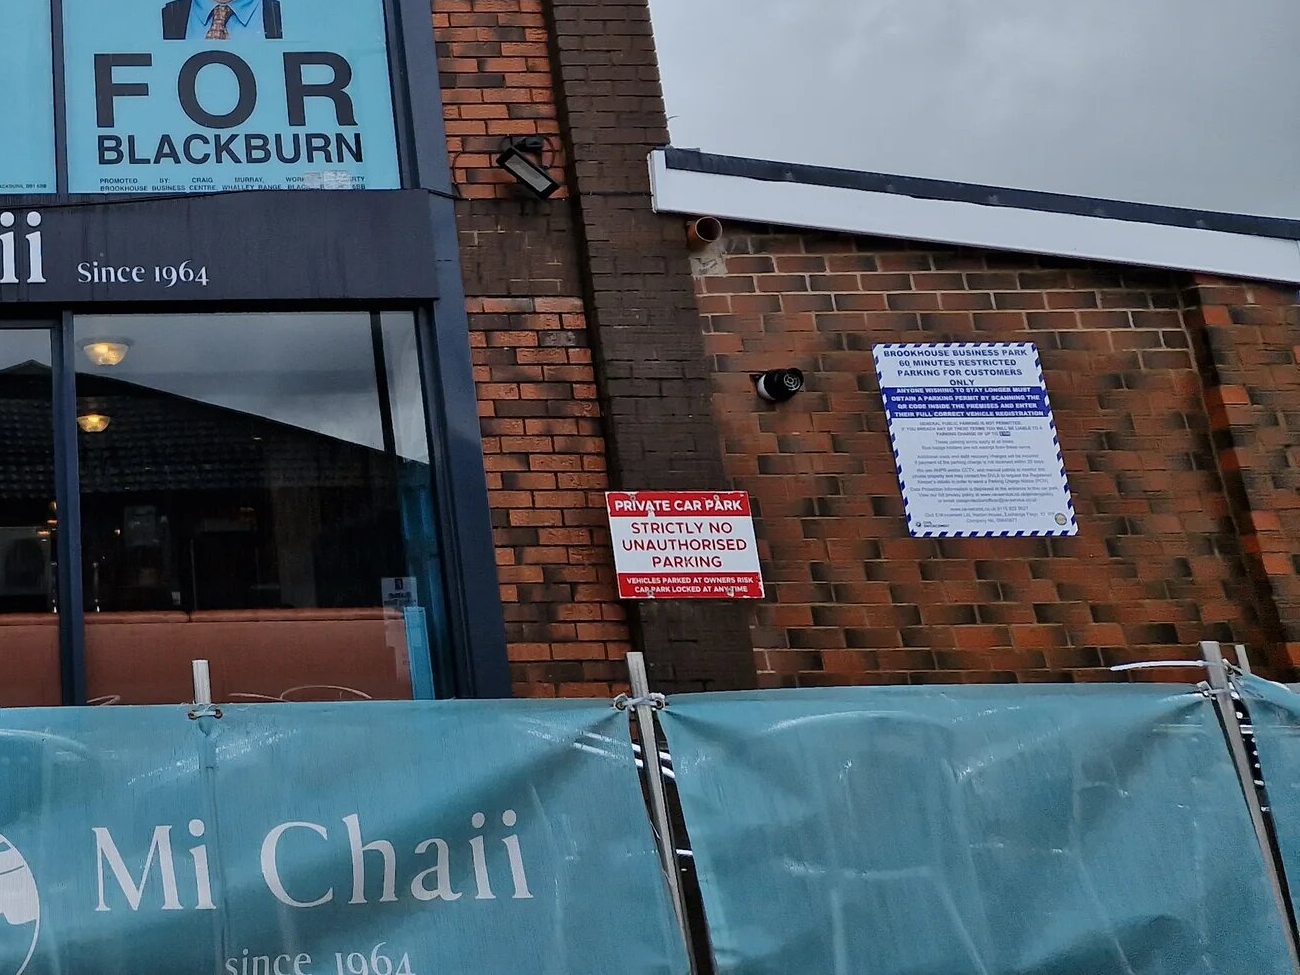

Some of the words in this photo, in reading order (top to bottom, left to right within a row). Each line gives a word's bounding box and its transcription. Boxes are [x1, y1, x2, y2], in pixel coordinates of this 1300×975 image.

[94, 50, 358, 129] FOR
[97, 132, 363, 165] BLACKBURN
[77, 260, 145, 285] Since
[154, 260, 209, 287] 1964
[615, 500, 671, 511] PRIVATE
[674, 500, 702, 511] CAR
[706, 499, 743, 511] PARK
[632, 522, 703, 534] STRICTLY
[709, 522, 733, 534] NO
[622, 539, 747, 551] UNAUTHORISED
[652, 556, 722, 568] PARKING
[730, 585, 748, 593] TIME
[91, 818, 217, 913] Mi
[260, 809, 534, 908] Chaii
[225, 948, 312, 975] since
[335, 942, 415, 975] 1964
